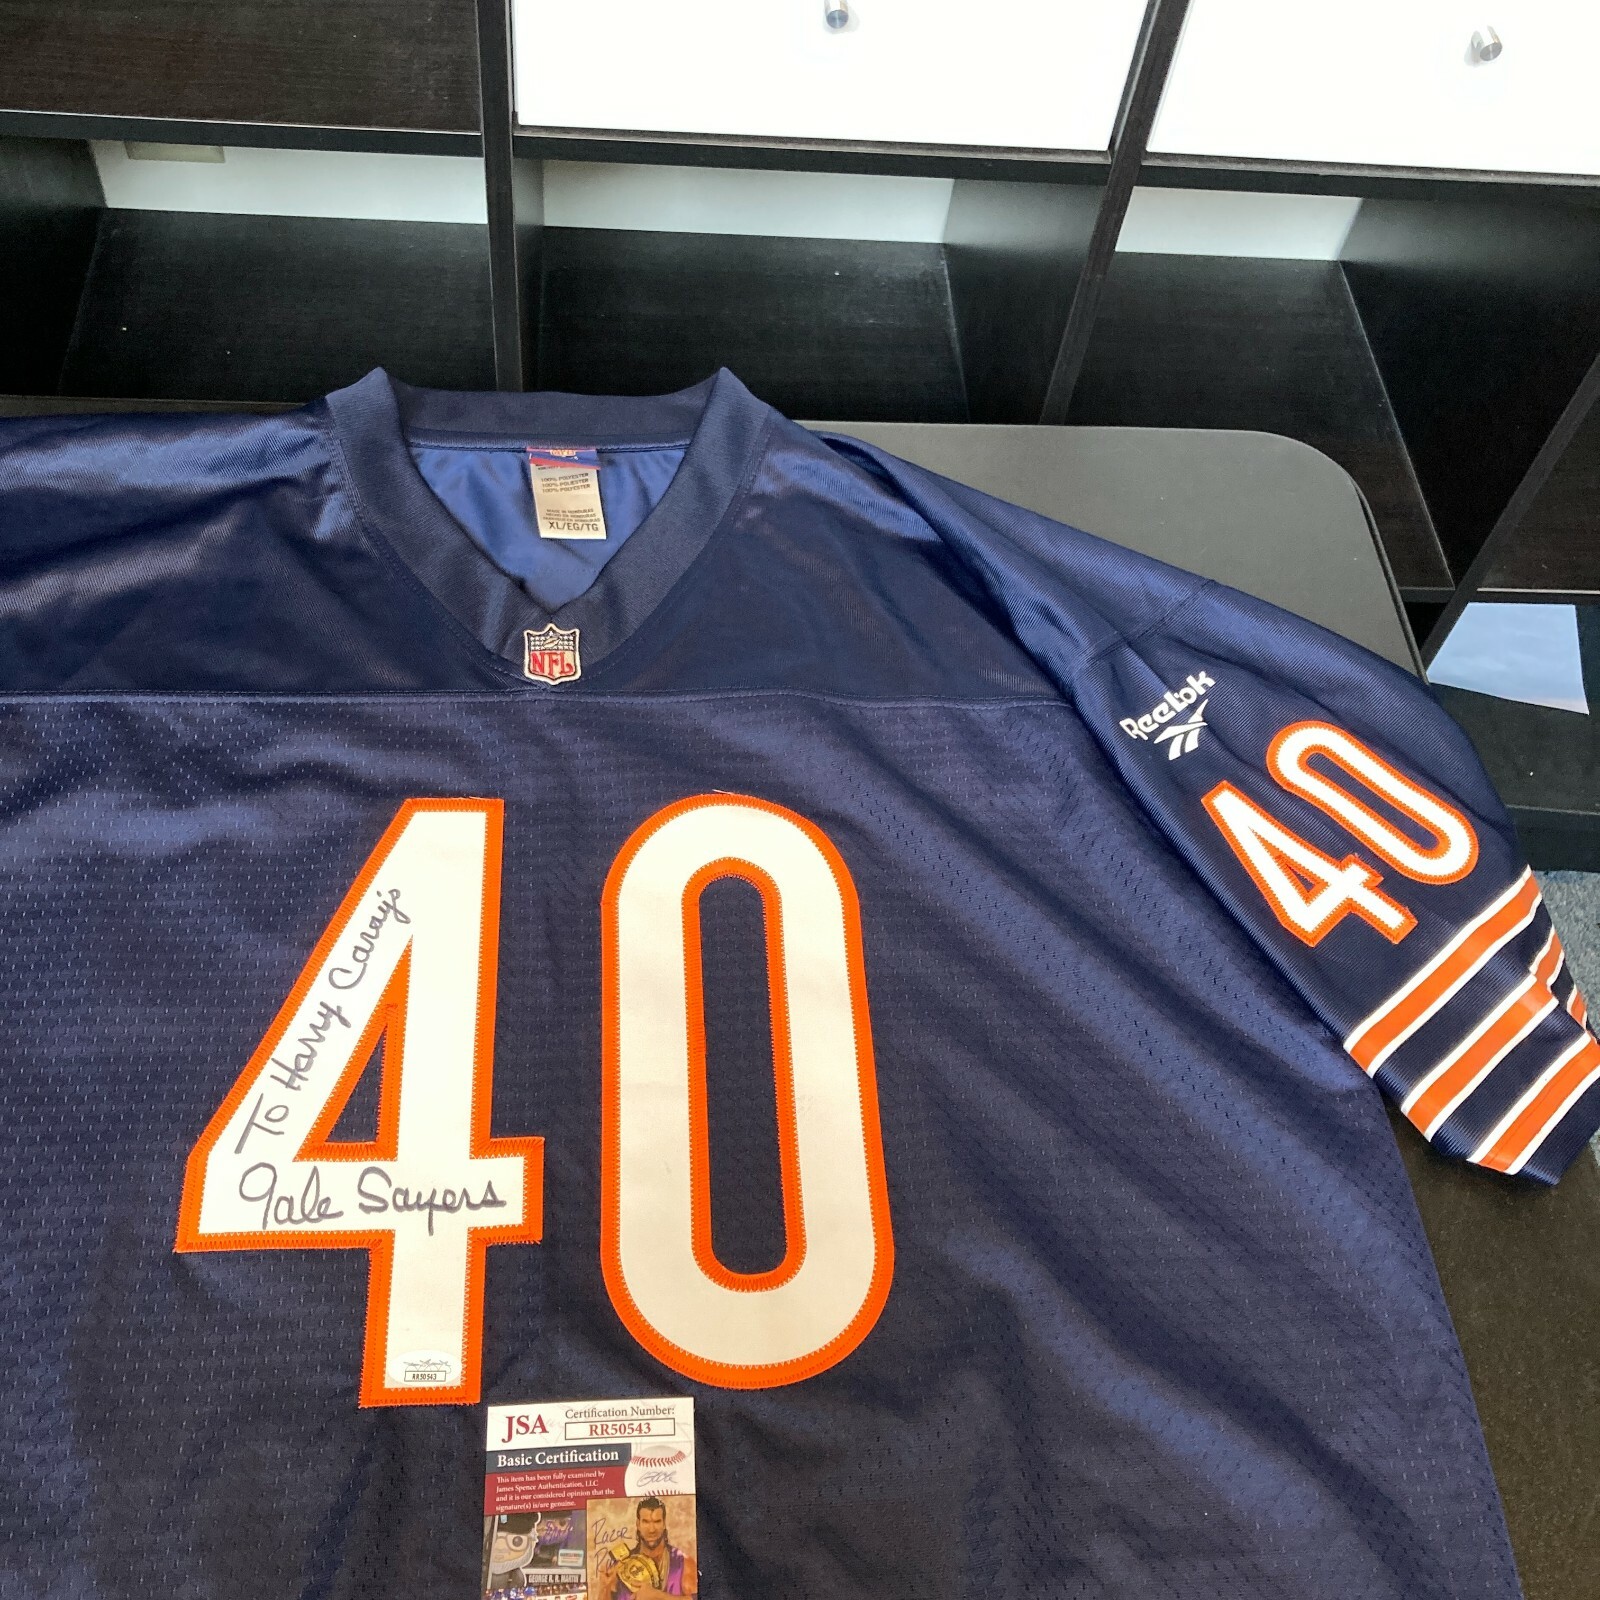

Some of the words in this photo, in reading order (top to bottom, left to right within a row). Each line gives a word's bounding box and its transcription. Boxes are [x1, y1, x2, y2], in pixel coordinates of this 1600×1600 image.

[559, 472, 589, 480] POLYESTER
[560, 484, 590, 493] POLYESTER
[549, 521, 599, 531] XL/EG/TG
[530, 651, 574, 678] NFL
[1119, 671, 1216, 740] Reebok
[1200, 720, 1479, 947] 40
[176, 794, 895, 1408] 40
[234, 1093, 289, 1154] To
[238, 1161, 345, 1230] Gale
[356, 1166, 507, 1237] Sayers
[565, 1406, 628, 1419] Certification
[630, 1405, 675, 1417] Number:
[501, 1414, 549, 1443] JSA
[589, 1422, 651, 1436] RR50543
[497, 1453, 533, 1468] Basic
[534, 1450, 619, 1465] Certification
[496, 1476, 510, 1484] This
[510, 1475, 524, 1483] item
[525, 1474, 536, 1482] has
[537, 1473, 552, 1481] been
[552, 1472, 567, 1482] fully
[567, 1471, 597, 1480] examined
[597, 1470, 606, 1479] by
[496, 1485, 514, 1493] James
[515, 1484, 536, 1492] Spence
[537, 1481, 584, 1490] Authentication,
[532, 1491, 566, 1500] considered
[566, 1490, 591, 1499] opinion
[591, 1488, 604, 1496] that
[495, 1502, 531, 1512] signature(s)
[532, 1501, 549, 1509] is/are
[550, 1500, 577, 1509] genuine.
